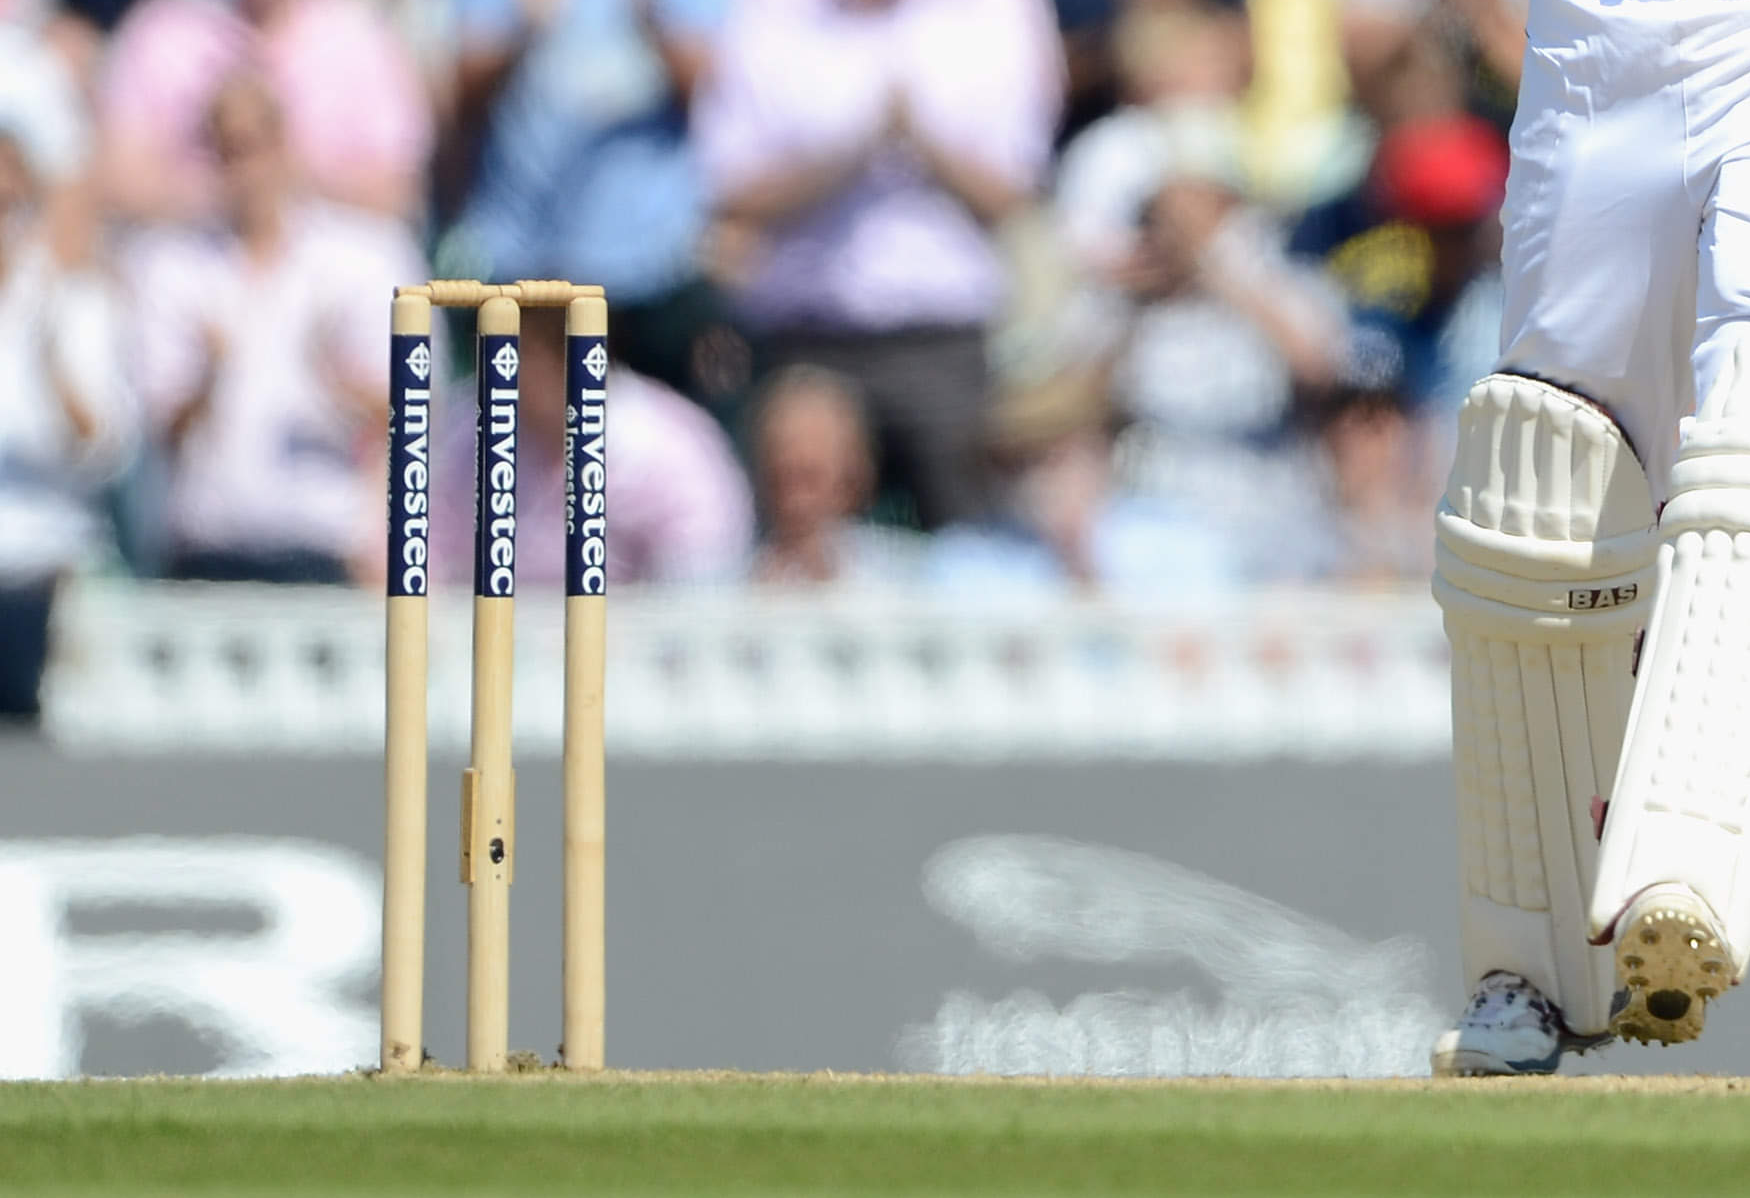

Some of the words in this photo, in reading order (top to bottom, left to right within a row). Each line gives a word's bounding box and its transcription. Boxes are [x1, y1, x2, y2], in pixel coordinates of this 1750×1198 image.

[402, 388, 431, 595] Investec
[490, 388, 520, 595] Investec
[581, 388, 607, 595] Investec
[1568, 584, 1638, 610] BAS
